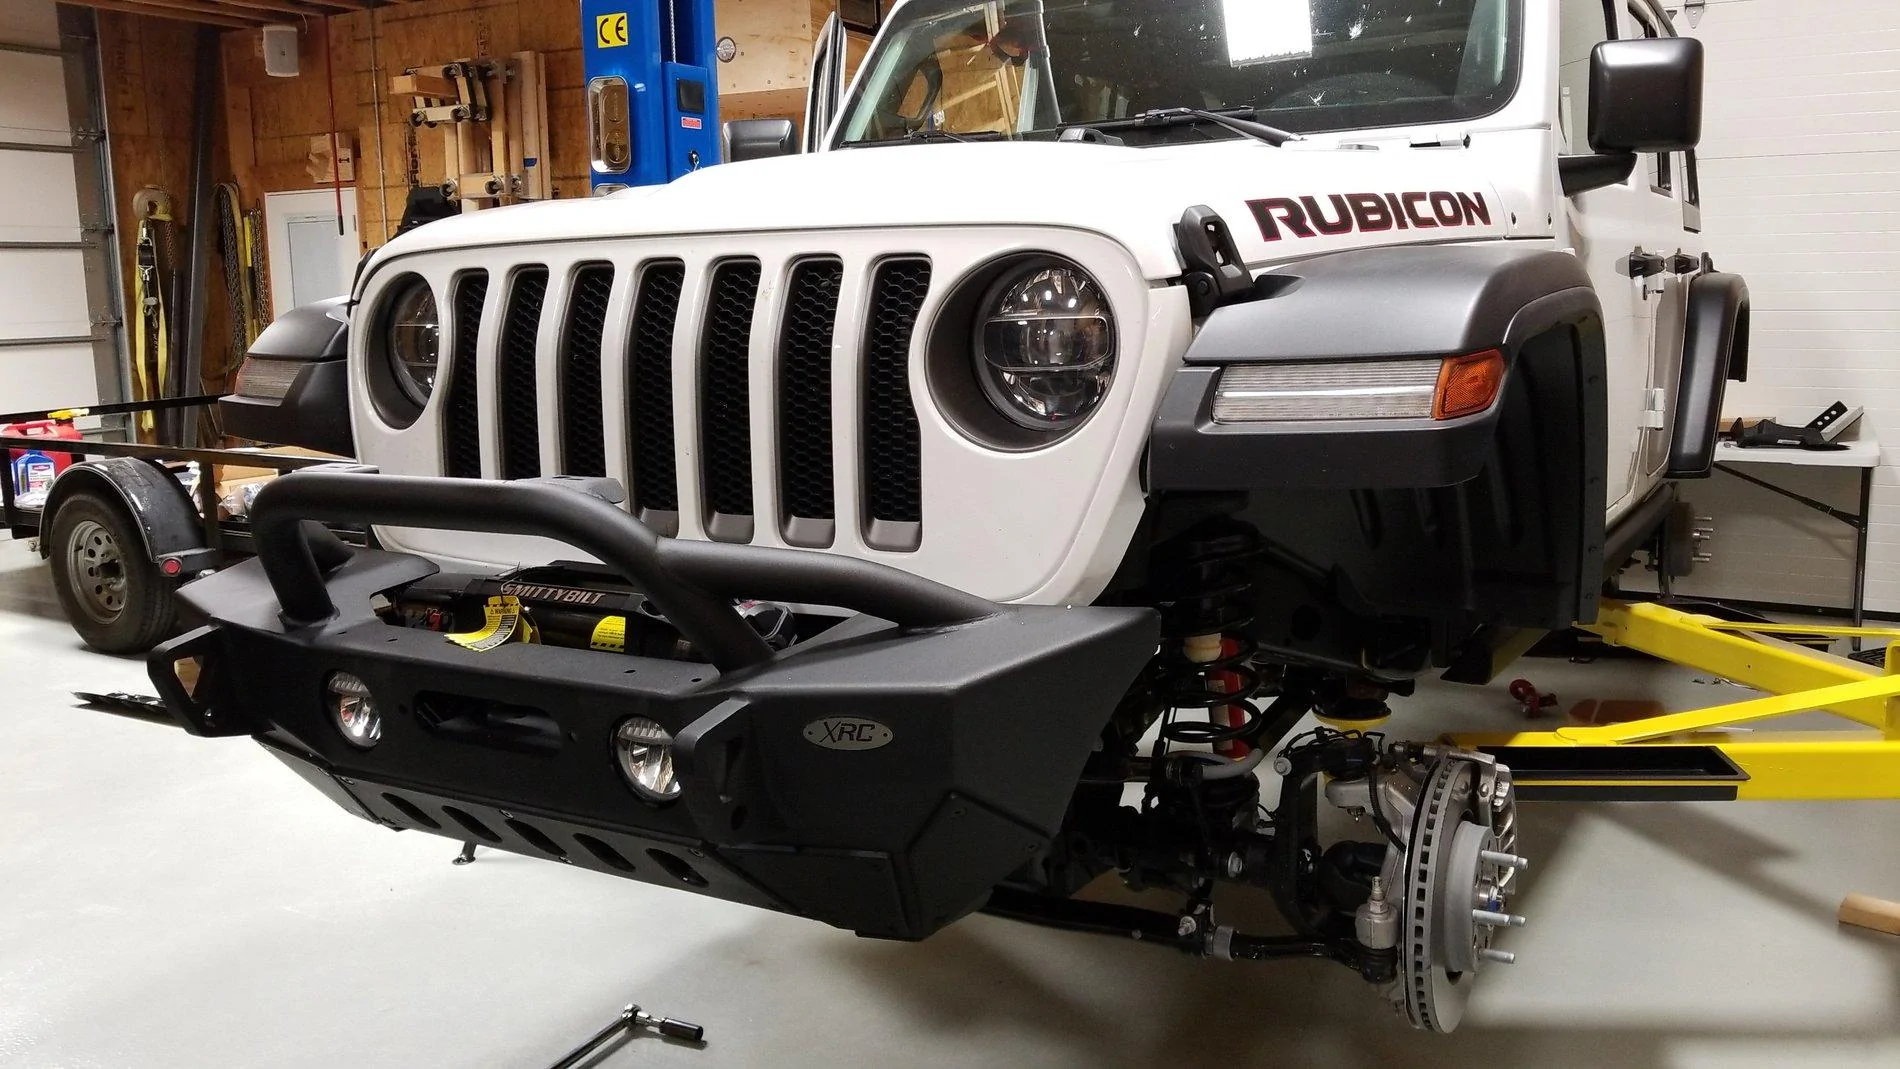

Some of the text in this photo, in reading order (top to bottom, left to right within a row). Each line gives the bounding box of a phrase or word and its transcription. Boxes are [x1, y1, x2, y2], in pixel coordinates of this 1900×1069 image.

[600, 16, 626, 44] CE
[1244, 191, 1492, 242] RUBICON
[503, 583, 606, 604] SMITTYBILT
[819, 721, 875, 743] XRC
